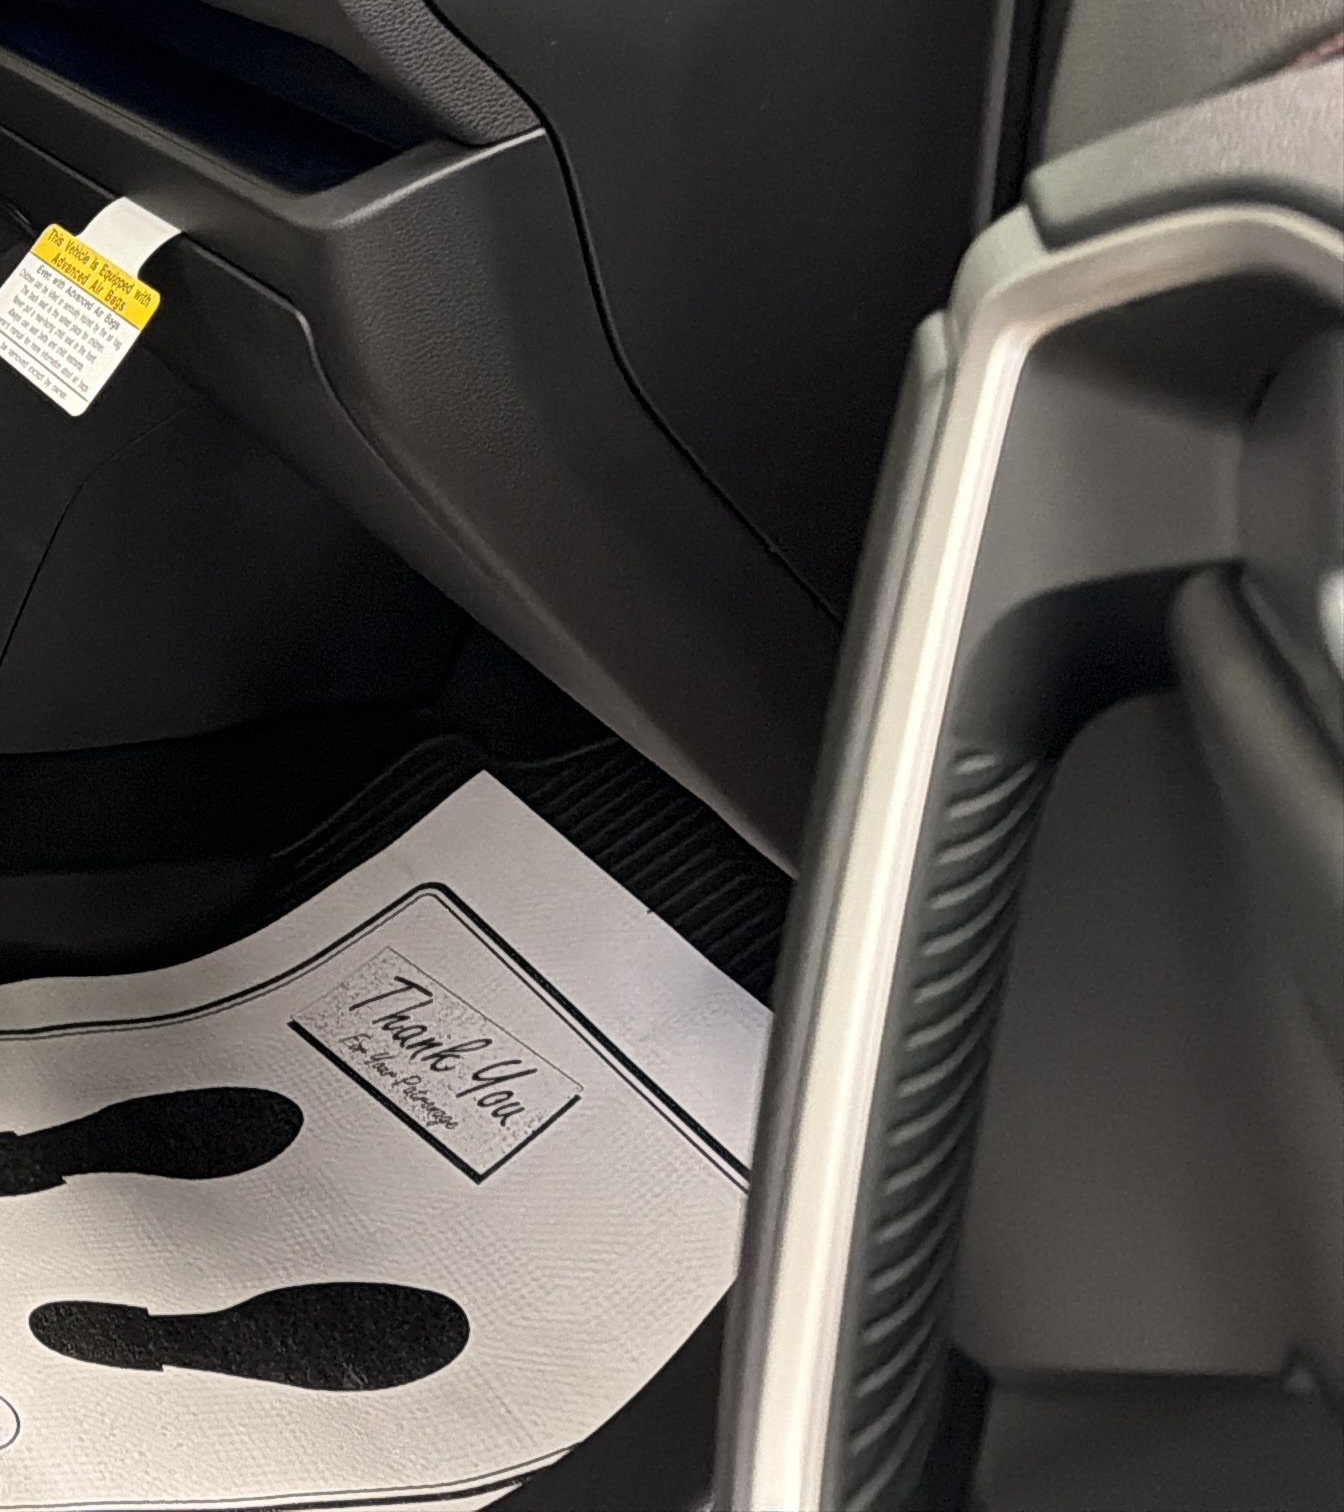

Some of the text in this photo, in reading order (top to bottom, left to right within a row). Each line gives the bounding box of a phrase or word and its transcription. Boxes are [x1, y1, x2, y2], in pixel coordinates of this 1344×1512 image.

[35, 264, 122, 331] Even with Advanced Air Bags
[46, 229, 66, 246] This
[62, 239, 92, 264] Vehicle
[96, 262, 137, 295] Equipped
[131, 287, 154, 307] with
[50, 252, 128, 313] Advanced Air Bags
[349, 976, 538, 1127] Thank You
[363, 1052, 397, 1079] Your
[392, 1075, 460, 1130] Patronage
